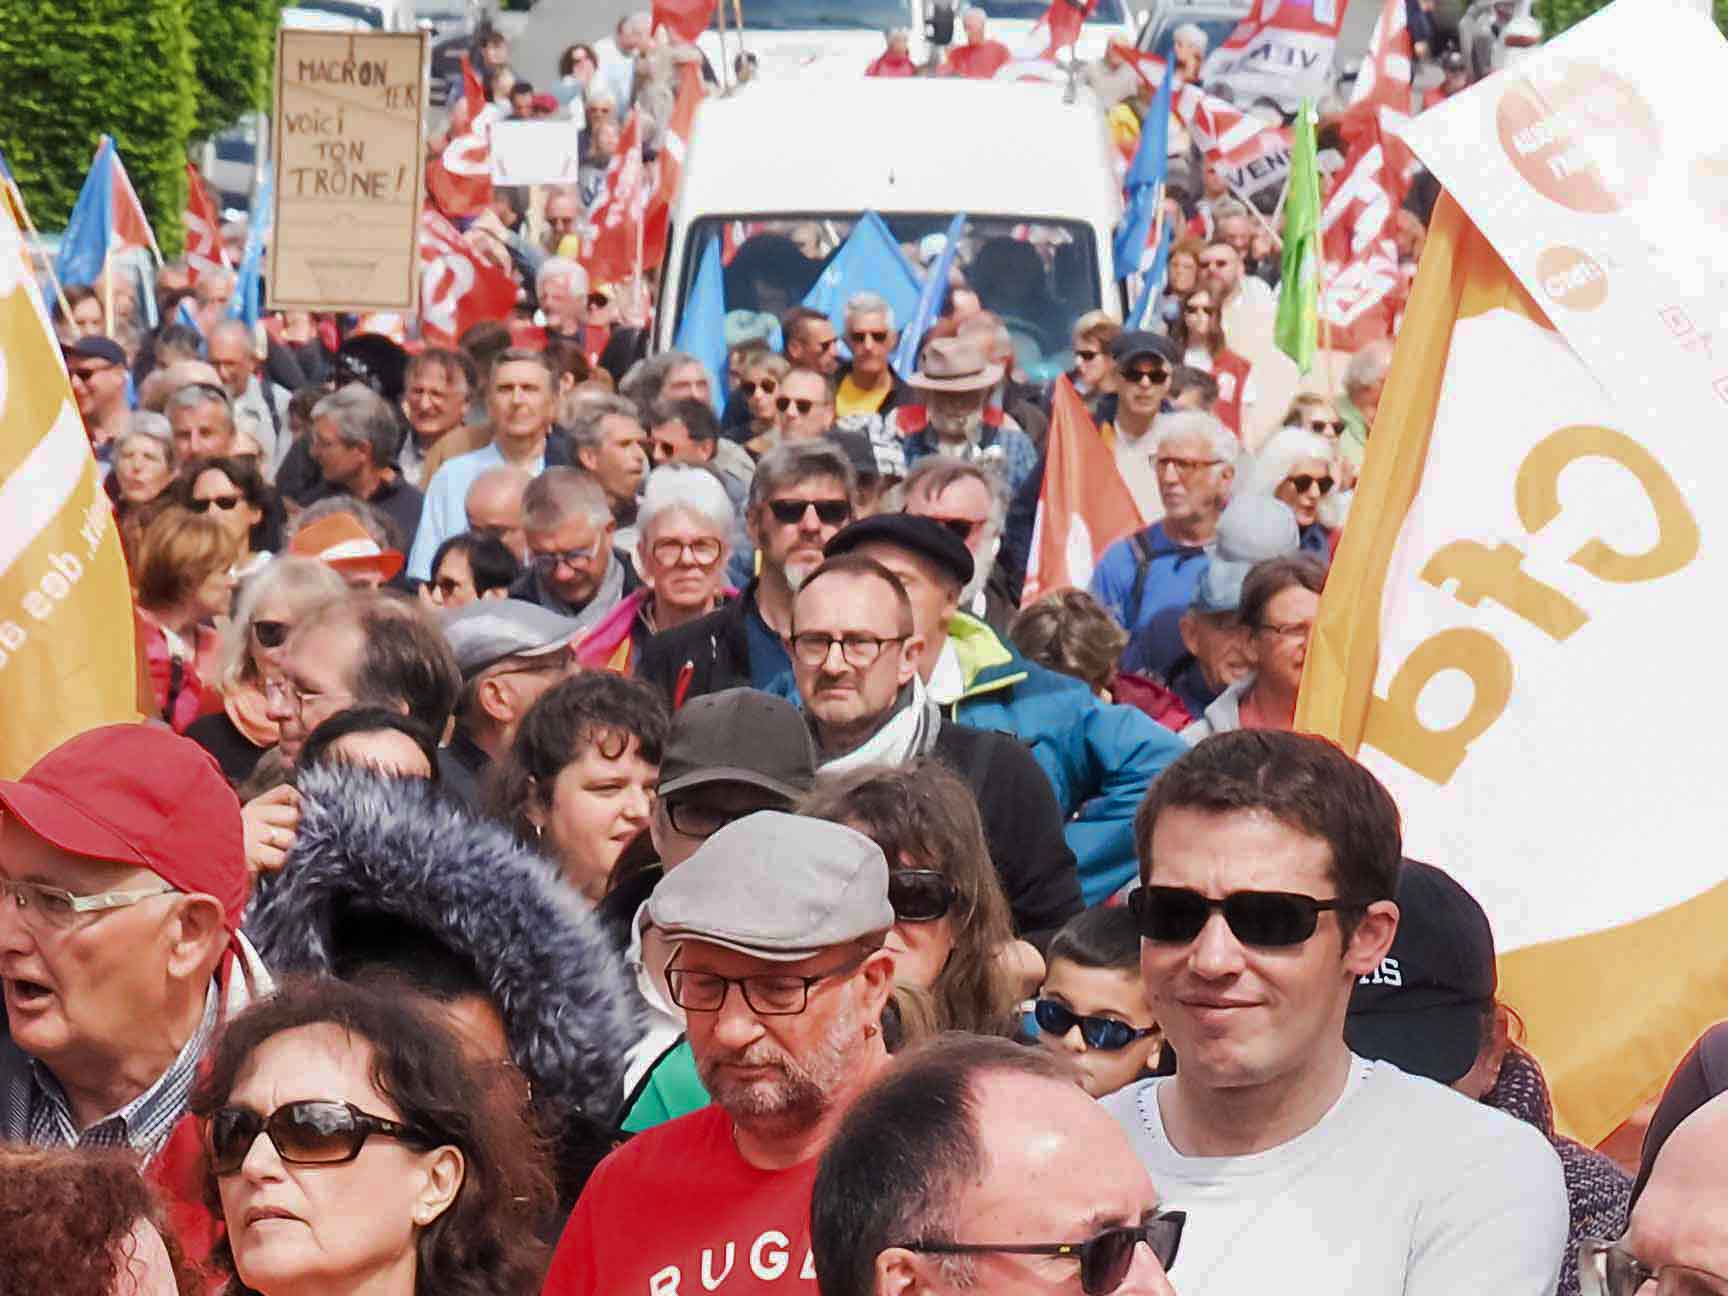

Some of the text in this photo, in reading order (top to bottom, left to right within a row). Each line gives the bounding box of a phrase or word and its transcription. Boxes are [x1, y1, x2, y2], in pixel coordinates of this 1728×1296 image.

[298, 58, 388, 87] MACRON
[313, 141, 364, 162] TON
[1228, 149, 1289, 189] VEN
